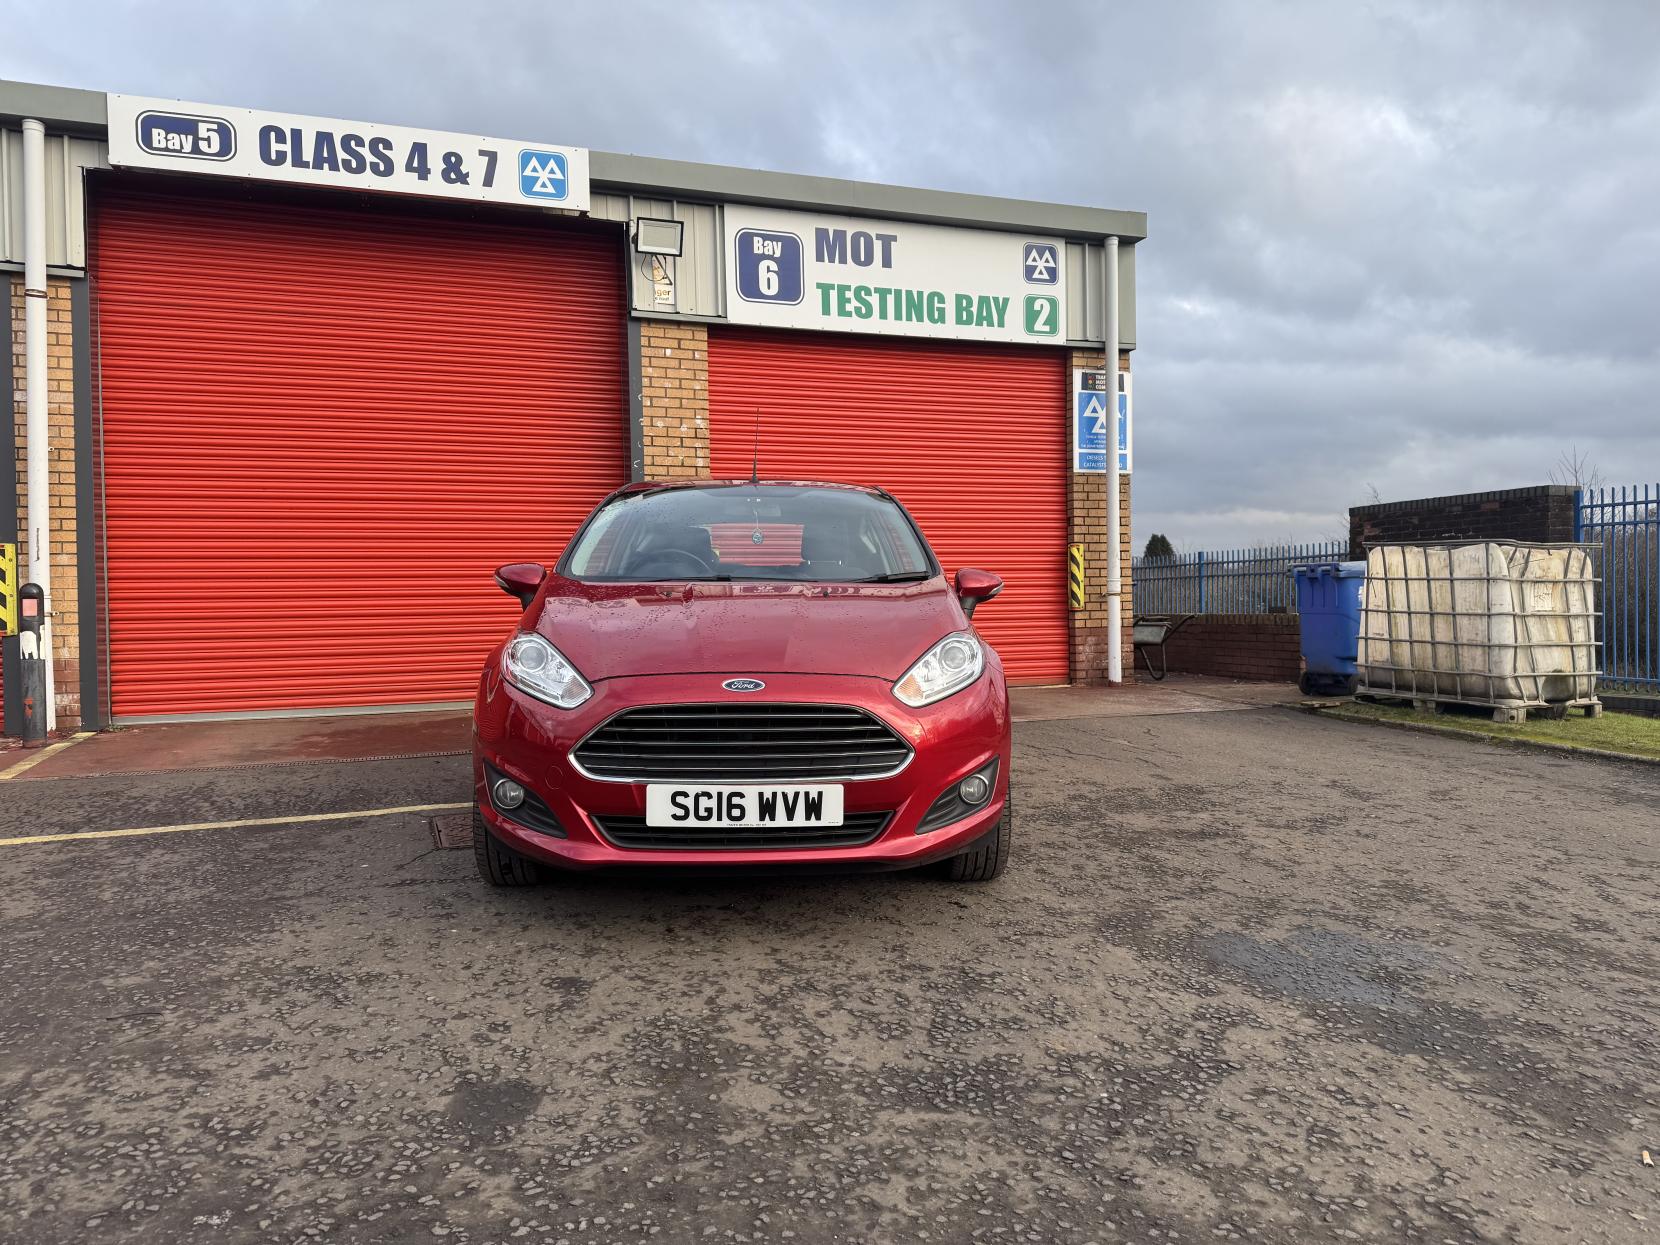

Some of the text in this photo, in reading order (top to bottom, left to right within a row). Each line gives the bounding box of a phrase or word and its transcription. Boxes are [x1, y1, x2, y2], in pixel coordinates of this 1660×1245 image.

[151, 123, 220, 154] Bay 5
[258, 125, 498, 188] CLASS 4 & 7
[753, 237, 782, 256] Bay
[814, 227, 898, 269] MOT
[758, 259, 779, 296] 6
[816, 282, 1010, 328] TESTING BAY
[1033, 300, 1052, 332] 2
[731, 681, 756, 689] Ford
[670, 791, 823, 822] SG16 WVW
